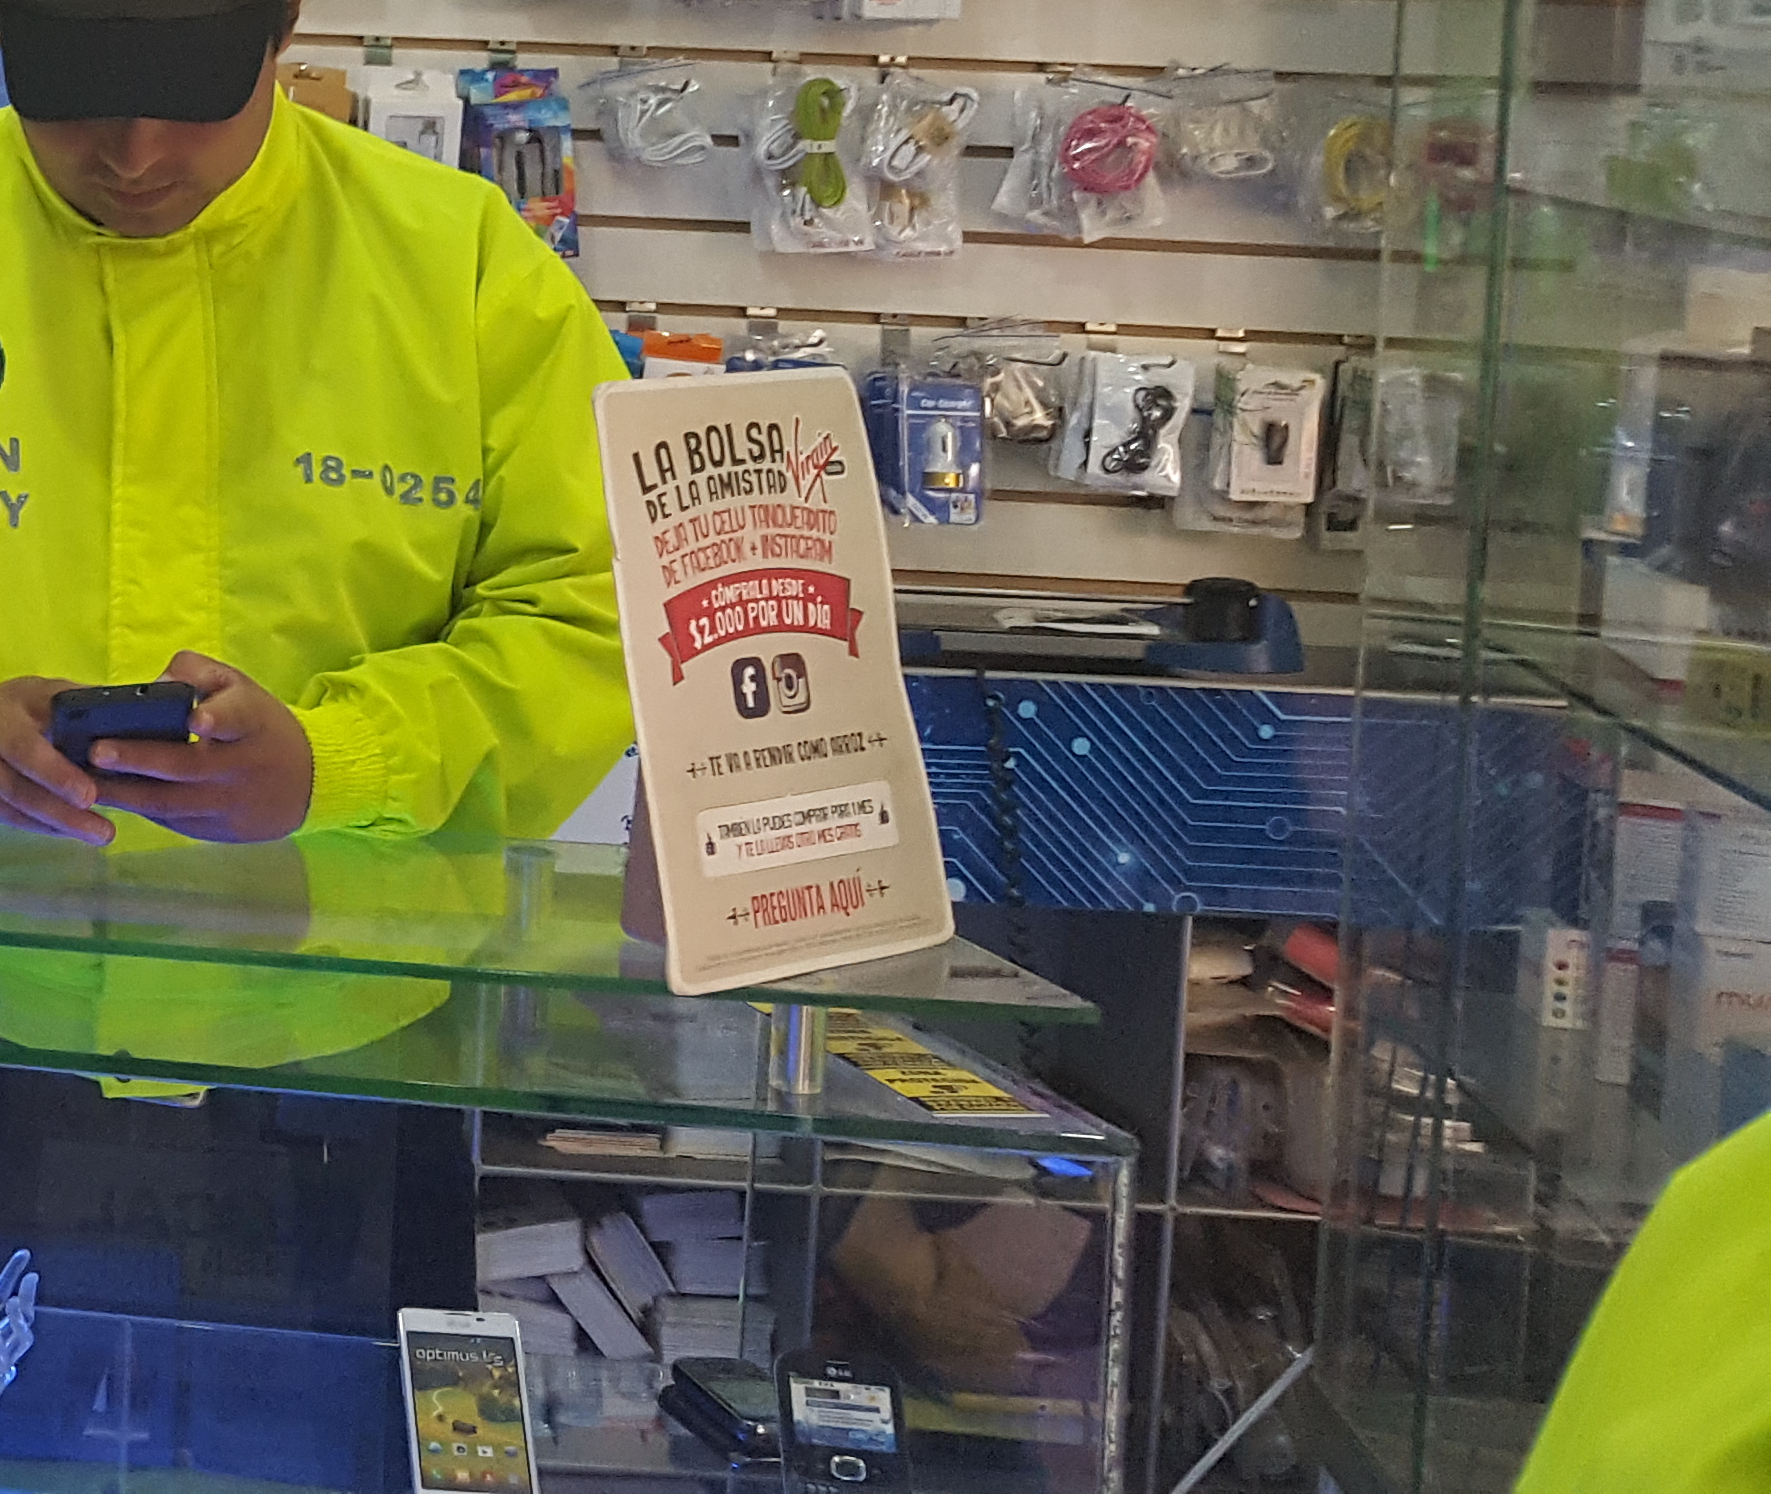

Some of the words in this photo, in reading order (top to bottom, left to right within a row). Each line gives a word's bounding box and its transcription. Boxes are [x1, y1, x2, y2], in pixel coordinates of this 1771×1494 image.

[294, 452, 483, 510] 18-0254
[632, 440, 677, 495] LA
[682, 421, 787, 476] BOLSA
[644, 491, 673, 525] DE
[674, 479, 703, 513] LA
[707, 467, 789, 503] AMISTAD
[653, 518, 691, 559] DEJA
[689, 512, 710, 544] TU
[681, 536, 746, 578] FACEBOOK
[759, 534, 834, 565] INSTAGRAM
[770, 577, 806, 599] DESDE
[687, 605, 745, 652] $2.000
[746, 599, 778, 630] POR
[782, 599, 806, 626] UN
[807, 595, 832, 631] DÍA
[709, 754, 725, 777] TE
[797, 737, 829, 763] COMO
[750, 883, 827, 930] PREGUNTA
[828, 866, 867, 918] AQUÍ
[414, 1346, 479, 1364] optimus
